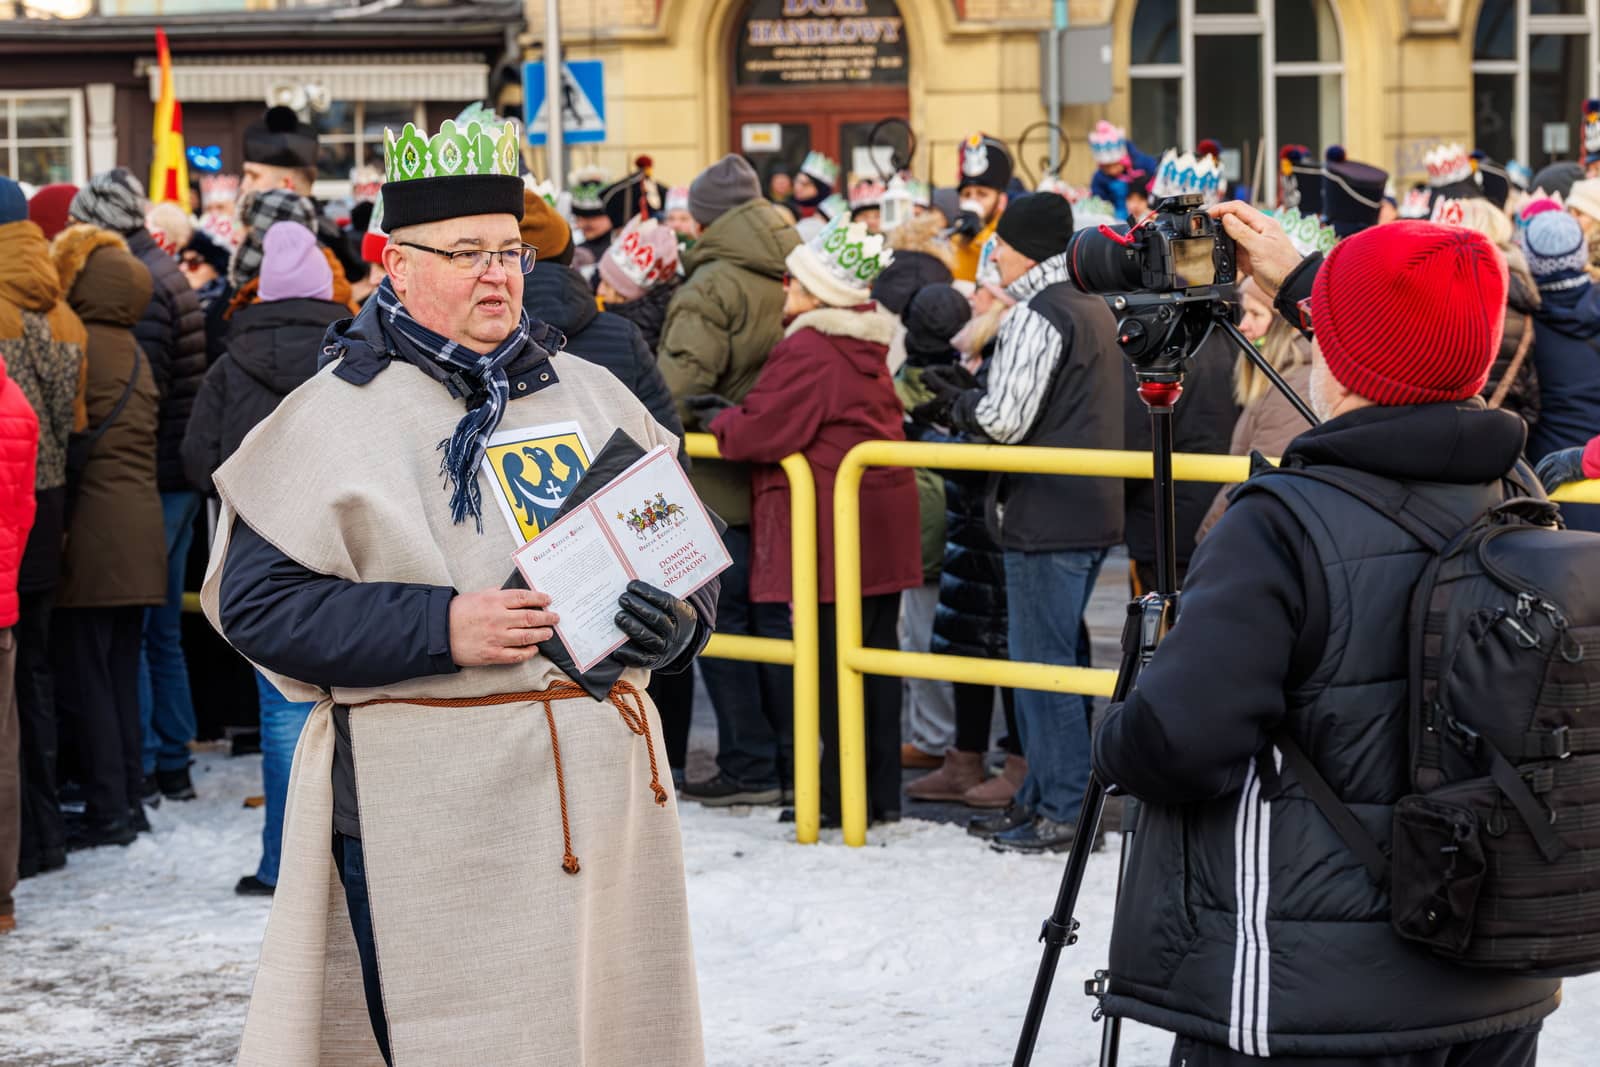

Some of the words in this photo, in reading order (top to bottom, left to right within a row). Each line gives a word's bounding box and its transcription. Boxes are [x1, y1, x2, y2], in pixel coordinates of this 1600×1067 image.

[747, 17, 902, 46] HANDLOWY
[658, 540, 695, 569] DOMOWY
[663, 553, 708, 588] ORSZAKOWY
